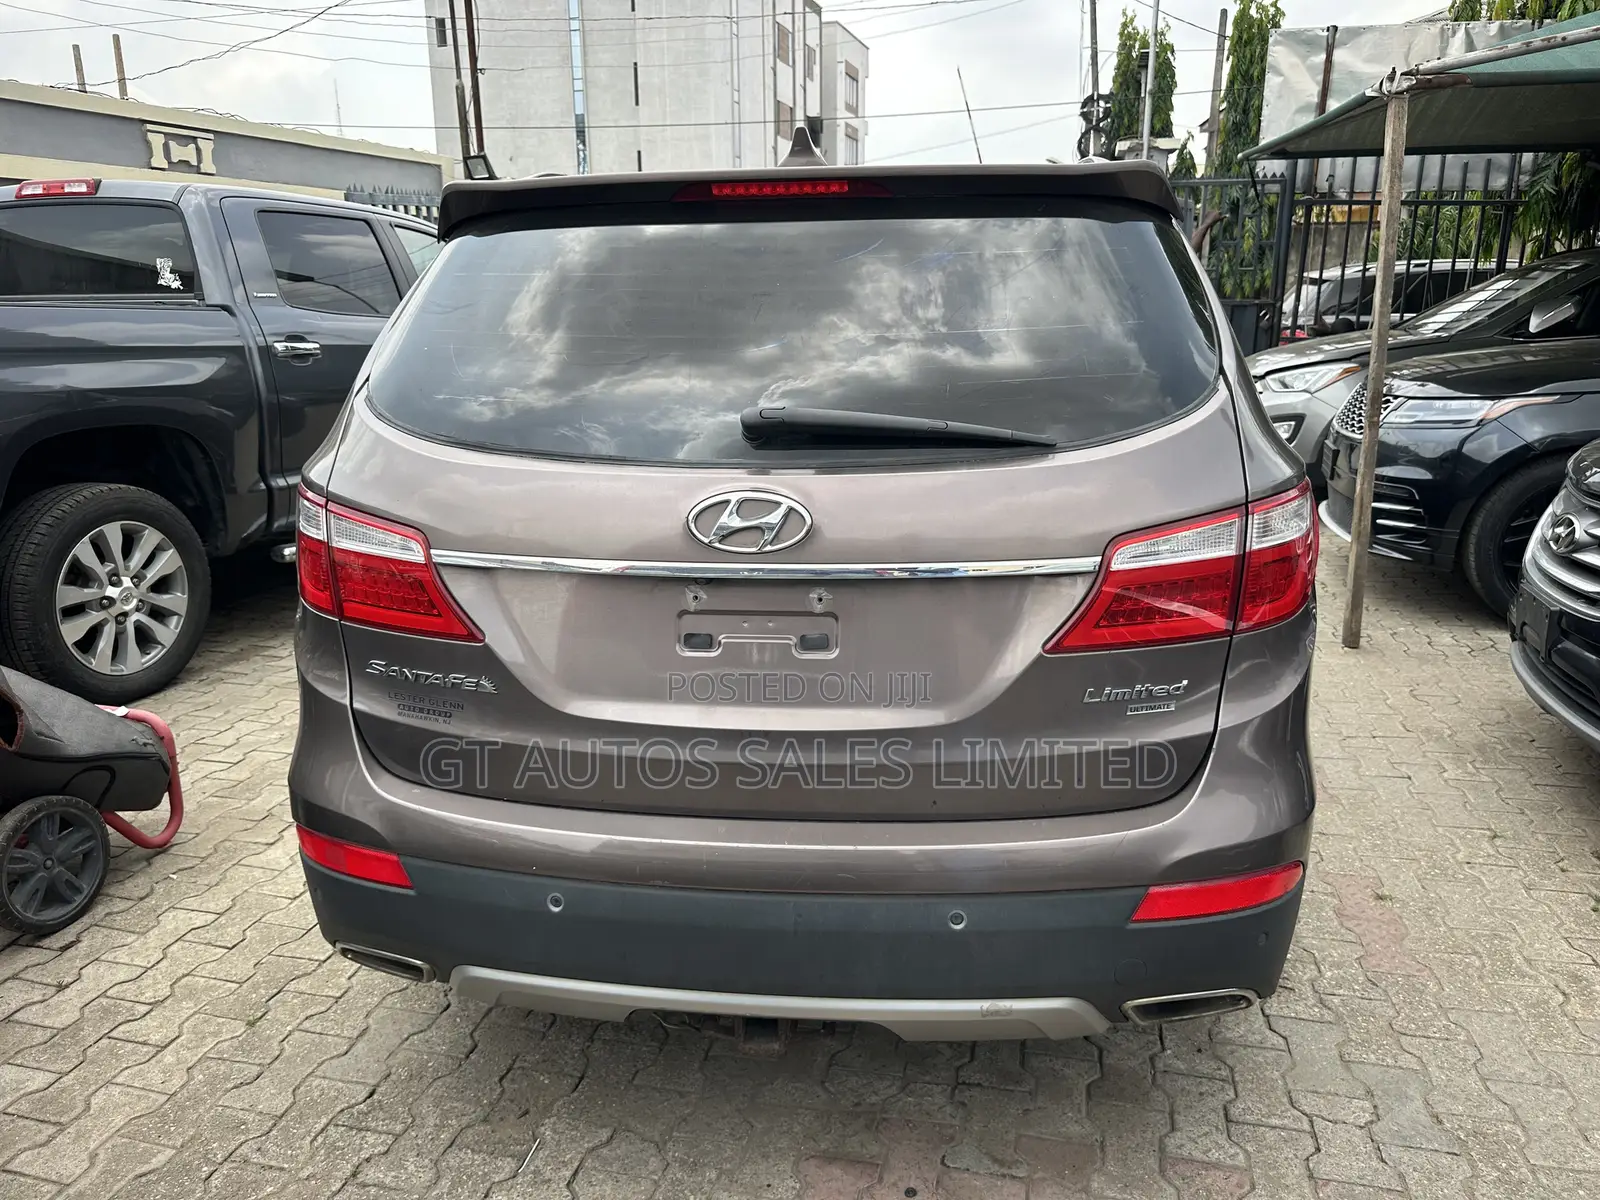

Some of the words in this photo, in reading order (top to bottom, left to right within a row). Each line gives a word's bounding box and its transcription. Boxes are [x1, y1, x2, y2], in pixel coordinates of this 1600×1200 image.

[1083, 680, 1188, 703] Limited
[388, 691, 425, 704] LESTER
[428, 698, 464, 711] GLENN
[1129, 702, 1172, 713] ULTIMATE
[399, 704, 420, 713] AUTO
[423, 708, 451, 717] GROUP
